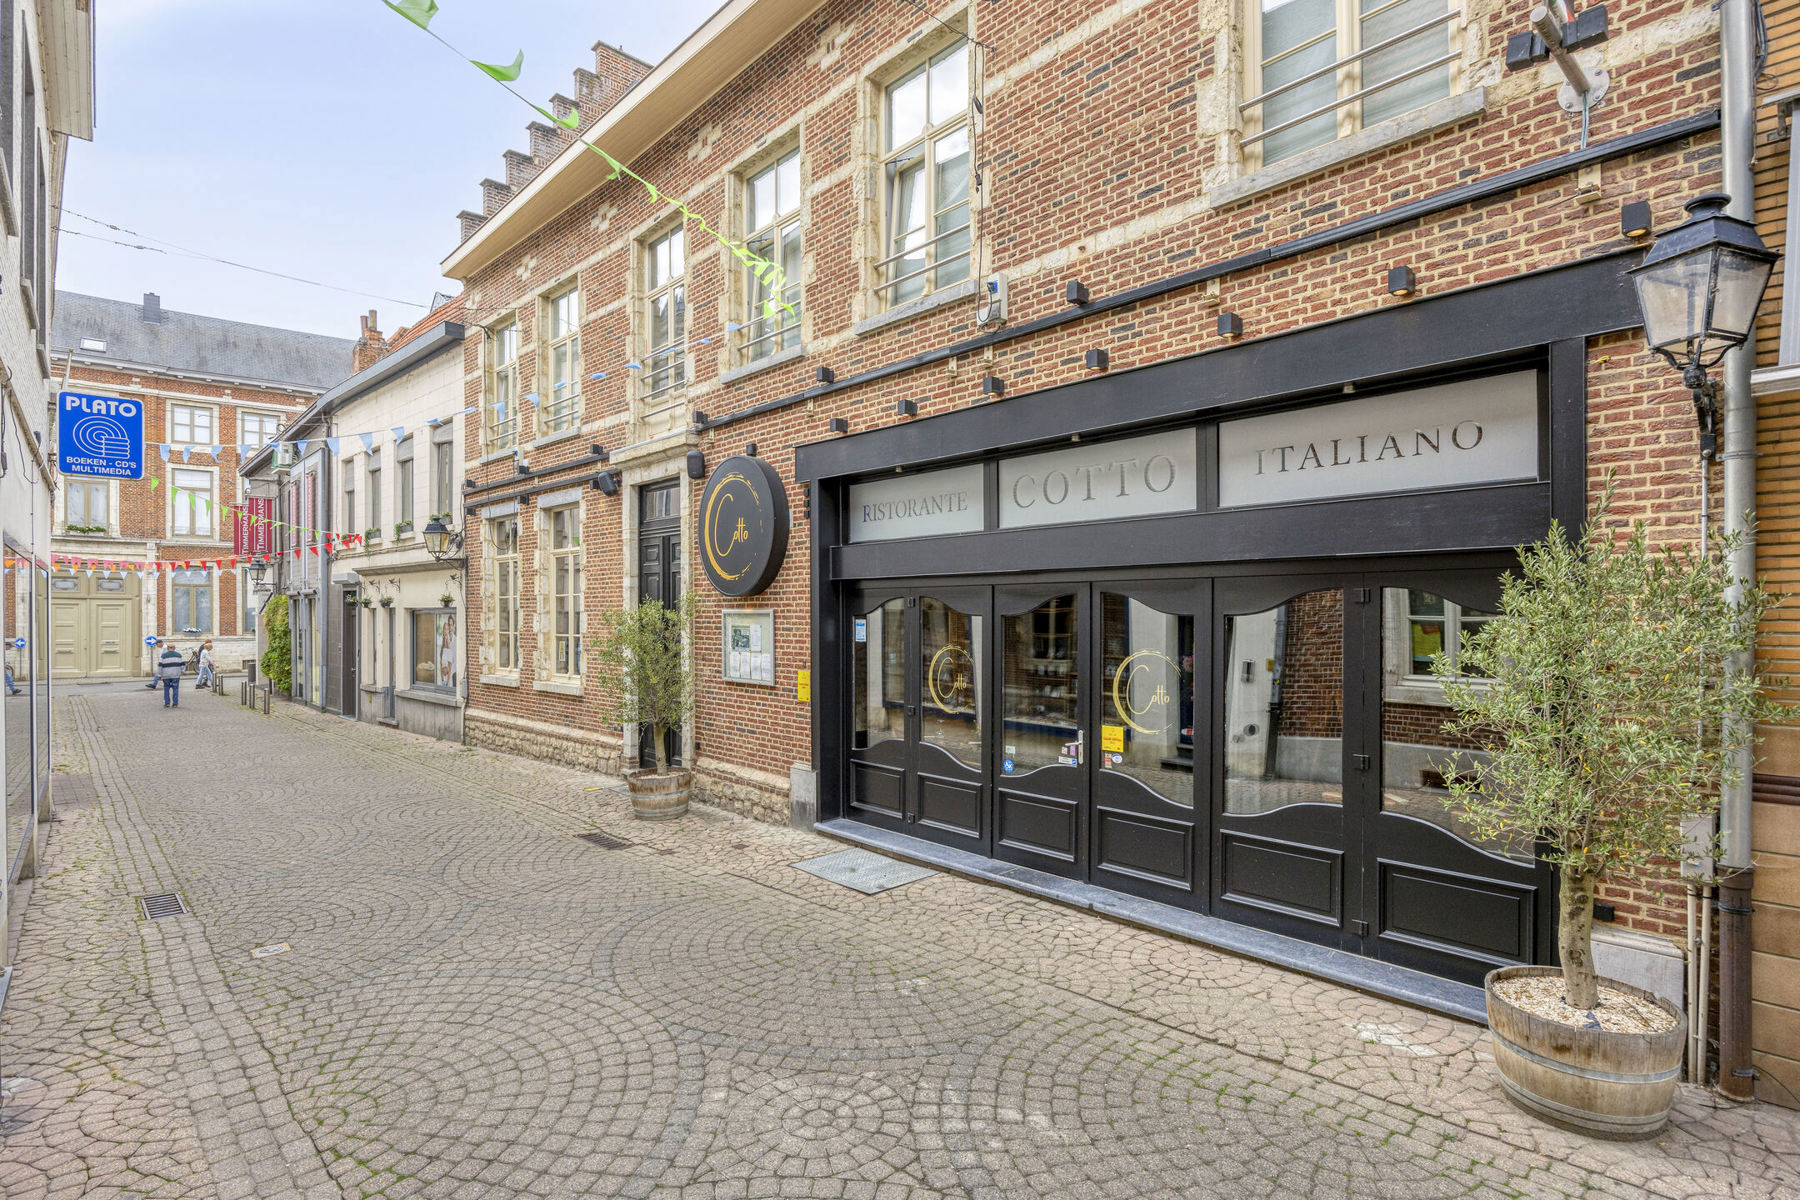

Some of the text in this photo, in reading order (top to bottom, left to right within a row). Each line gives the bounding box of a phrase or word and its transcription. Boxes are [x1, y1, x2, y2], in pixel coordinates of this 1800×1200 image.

[65, 395, 137, 418] PLATO
[66, 456, 107, 467] BOEKEN
[115, 460, 137, 469] CD'S
[71, 464, 132, 476] MULTIMEDIA
[862, 419, 1484, 523] RISTORANTE COTTO ITALIANO
[241, 506, 249, 555] TIMMERMANS
[256, 498, 265, 550] TIMMERMANS
[714, 492, 749, 557] Cotto
[937, 656, 967, 699] Cotto
[1126, 664, 1171, 715] Cotto
